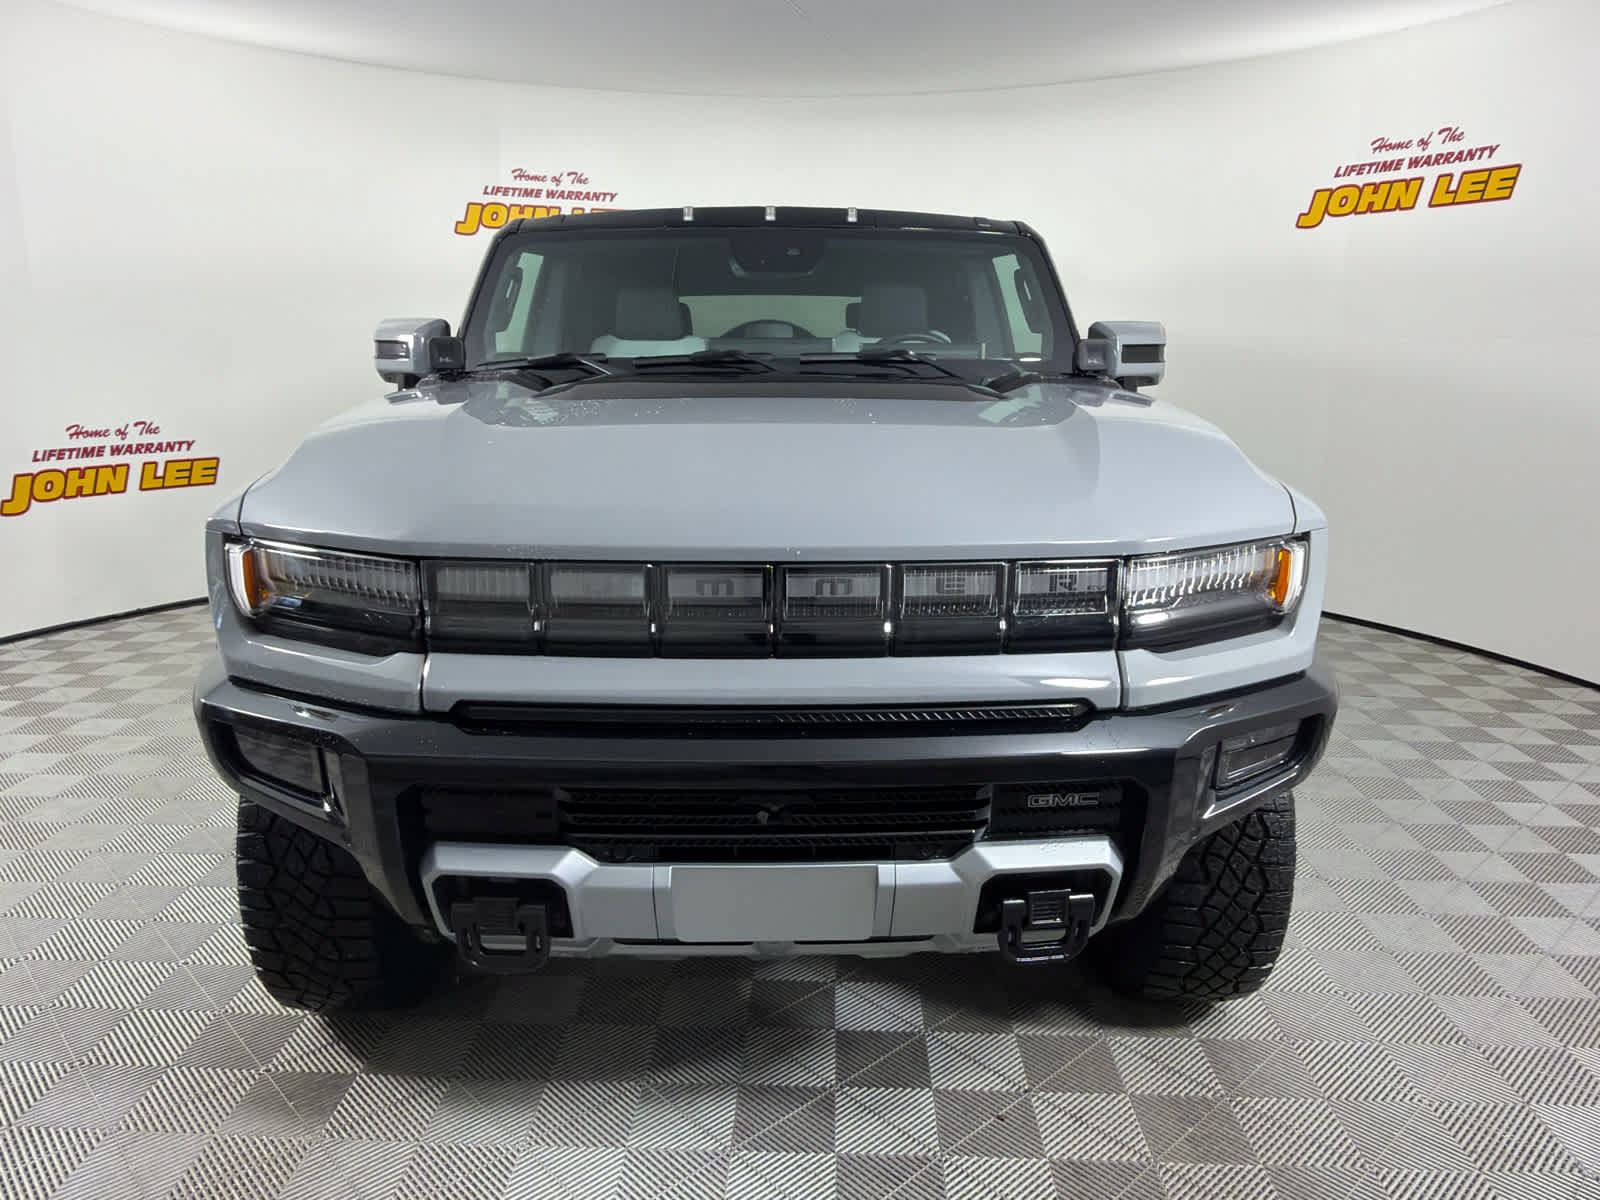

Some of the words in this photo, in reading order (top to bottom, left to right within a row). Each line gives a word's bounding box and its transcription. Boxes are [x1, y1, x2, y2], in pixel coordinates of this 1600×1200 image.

[1371, 136, 1413, 154] Home
[1416, 131, 1433, 151] of
[1437, 126, 1465, 145] The
[1334, 158, 1404, 178] LIFETIME
[1407, 144, 1500, 169] WARRANTY
[511, 168, 547, 183] Home
[551, 172, 564, 186] of
[566, 171, 589, 185] The
[482, 185, 542, 198] LIFETIME
[546, 189, 618, 203] WARRANTY
[1296, 176, 1424, 228] JOHN
[1428, 164, 1521, 208] LEE
[65, 424, 110, 440] Home
[114, 424, 129, 440] of
[133, 421, 160, 436] The
[32, 446, 105, 462] LIFETIME
[110, 440, 196, 456] WARRANTY
[0, 464, 130, 516] JOHN
[139, 457, 220, 491] LEE
[1027, 792, 1099, 808] GMC
